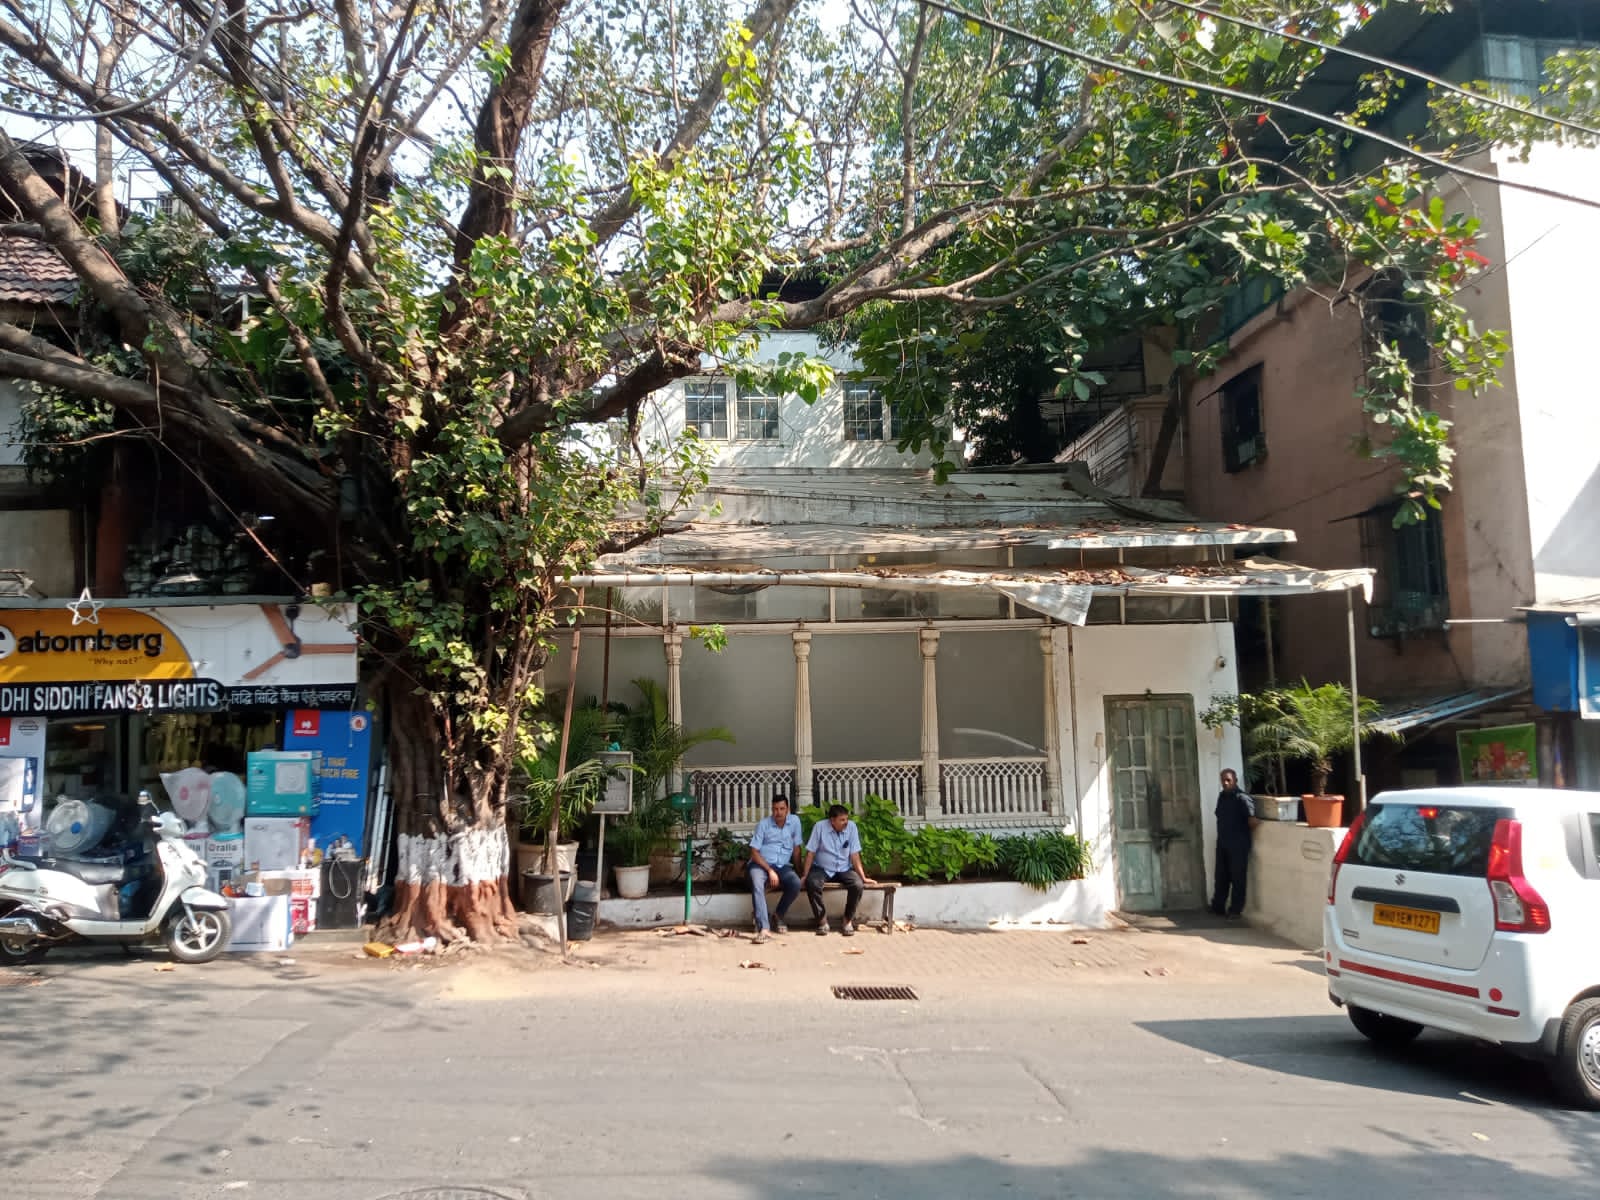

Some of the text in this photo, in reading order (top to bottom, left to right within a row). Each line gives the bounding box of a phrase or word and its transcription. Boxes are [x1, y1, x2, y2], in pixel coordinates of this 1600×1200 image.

[18, 629, 163, 657] atomberg
[1, 682, 219, 712] DHI SIDDHI FANS & LIGHTS
